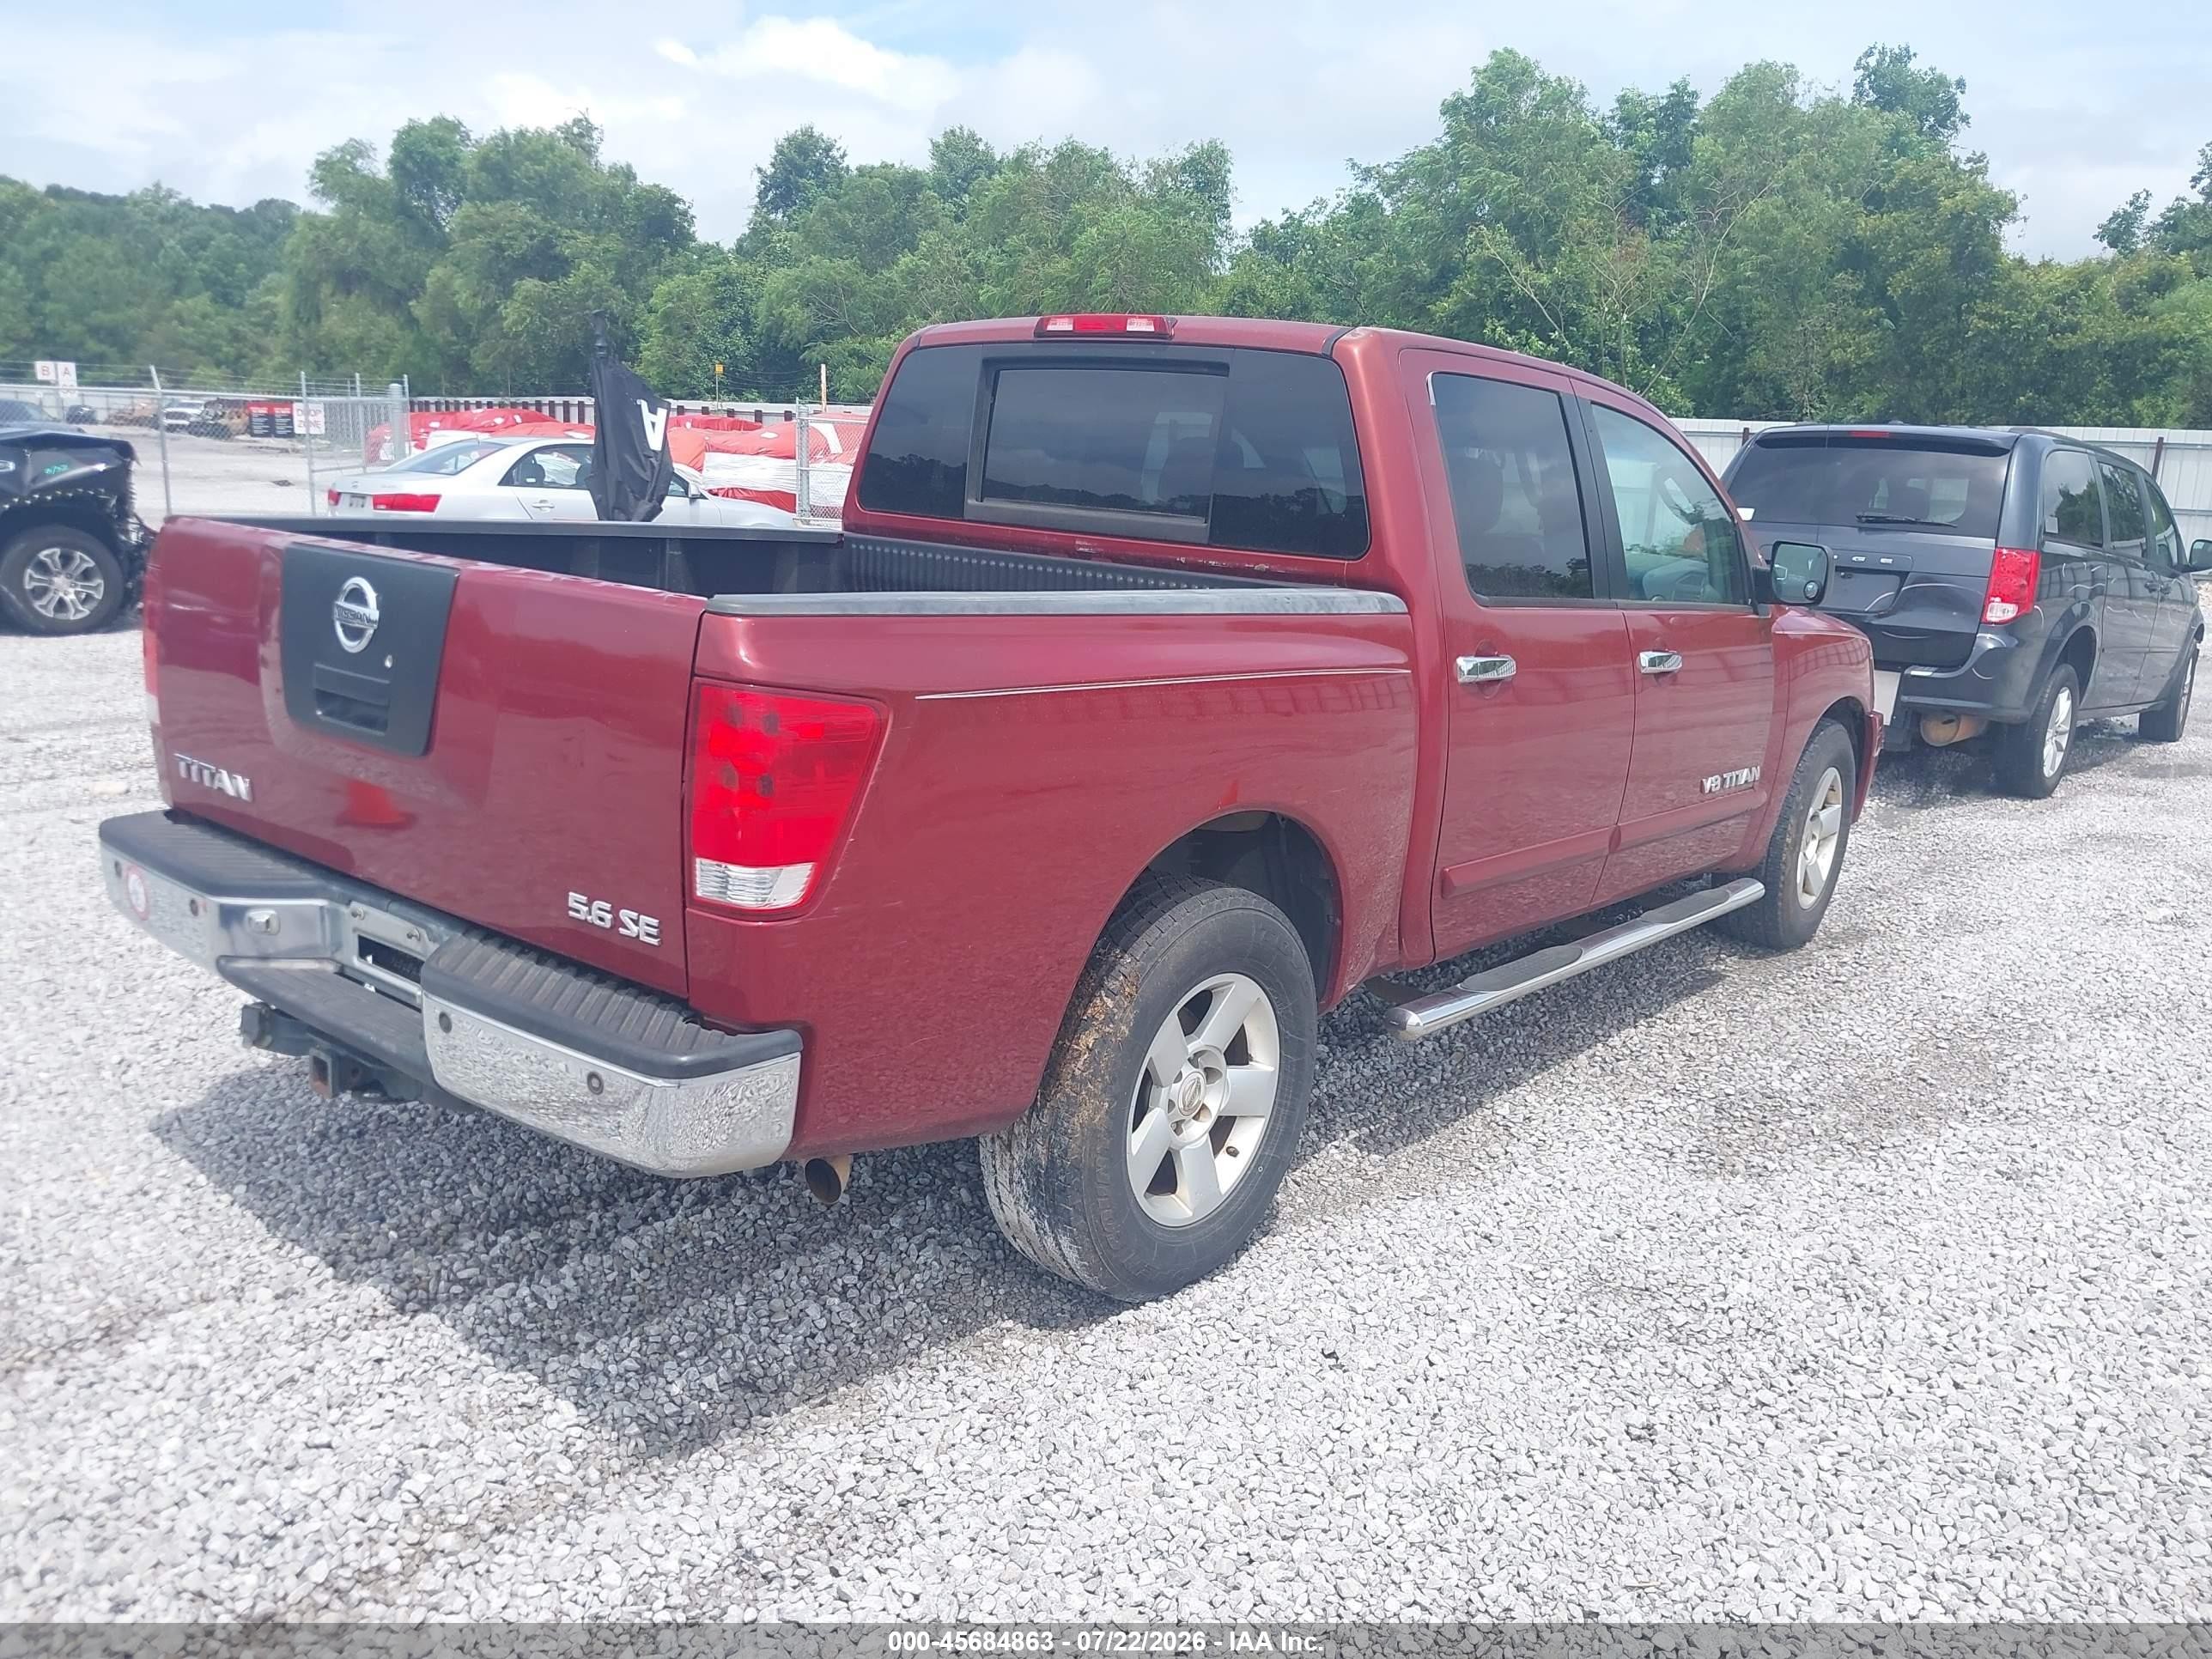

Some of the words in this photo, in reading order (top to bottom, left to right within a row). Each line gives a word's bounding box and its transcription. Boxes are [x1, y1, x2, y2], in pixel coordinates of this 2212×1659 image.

[62, 367, 72, 377] A
[296, 408, 322, 416] DOP
[636, 398, 668, 452] A
[173, 753, 252, 803] TITAN
[1723, 766, 1760, 788] TITAN
[568, 891, 613, 929] 5.6
[618, 908, 661, 946] SE
